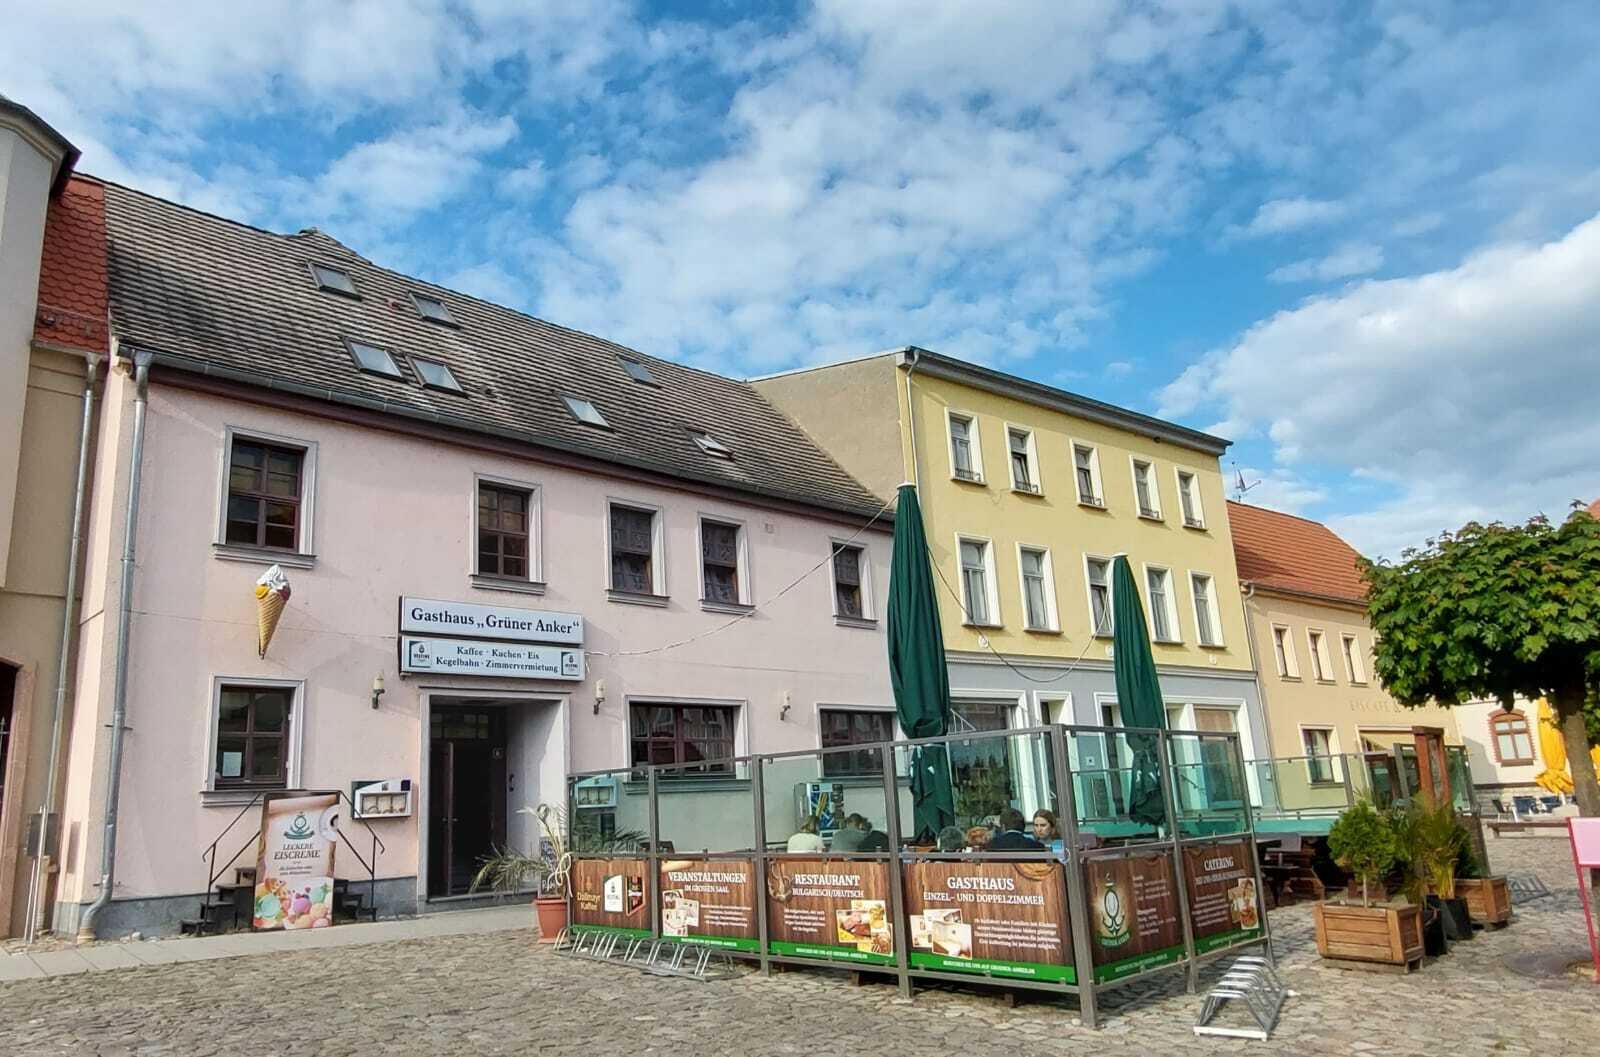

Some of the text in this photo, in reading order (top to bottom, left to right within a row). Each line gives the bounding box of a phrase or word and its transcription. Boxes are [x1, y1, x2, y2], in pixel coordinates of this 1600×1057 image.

[411, 607, 475, 626] Gasthaus
[457, 646, 540, 660] Kaffee Kuchen Eis
[436, 656, 480, 668] Kegelbahn
[485, 659, 558, 674] Zimmervermietung
[273, 850, 321, 860] EISCREME
[1203, 856, 1235, 872] CATERING
[668, 871, 747, 884] VERANSTALTUNGEN
[794, 873, 861, 887] RESTAURANT
[946, 876, 1016, 891] GASTHAUS
[923, 891, 1045, 905] EINZEL- UND DOPPELZIMMER
